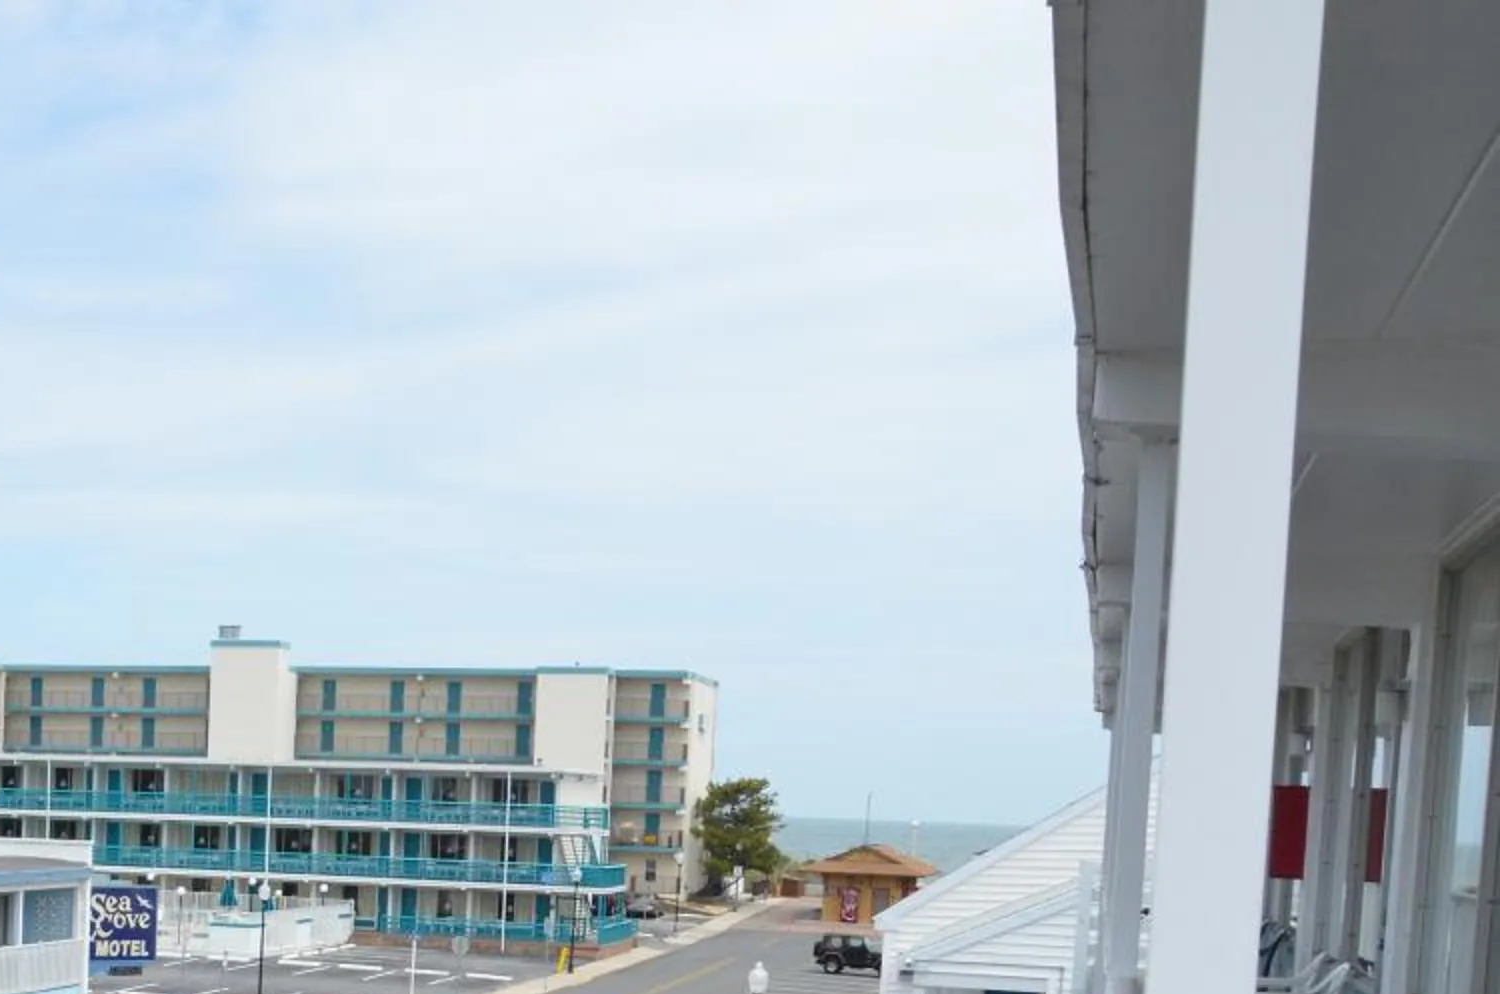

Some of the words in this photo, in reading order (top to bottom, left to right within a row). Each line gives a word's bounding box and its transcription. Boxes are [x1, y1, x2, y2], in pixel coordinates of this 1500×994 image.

[90, 894, 132, 921] Sea
[95, 911, 150, 938] Cove
[95, 940, 149, 957] MOTEL
